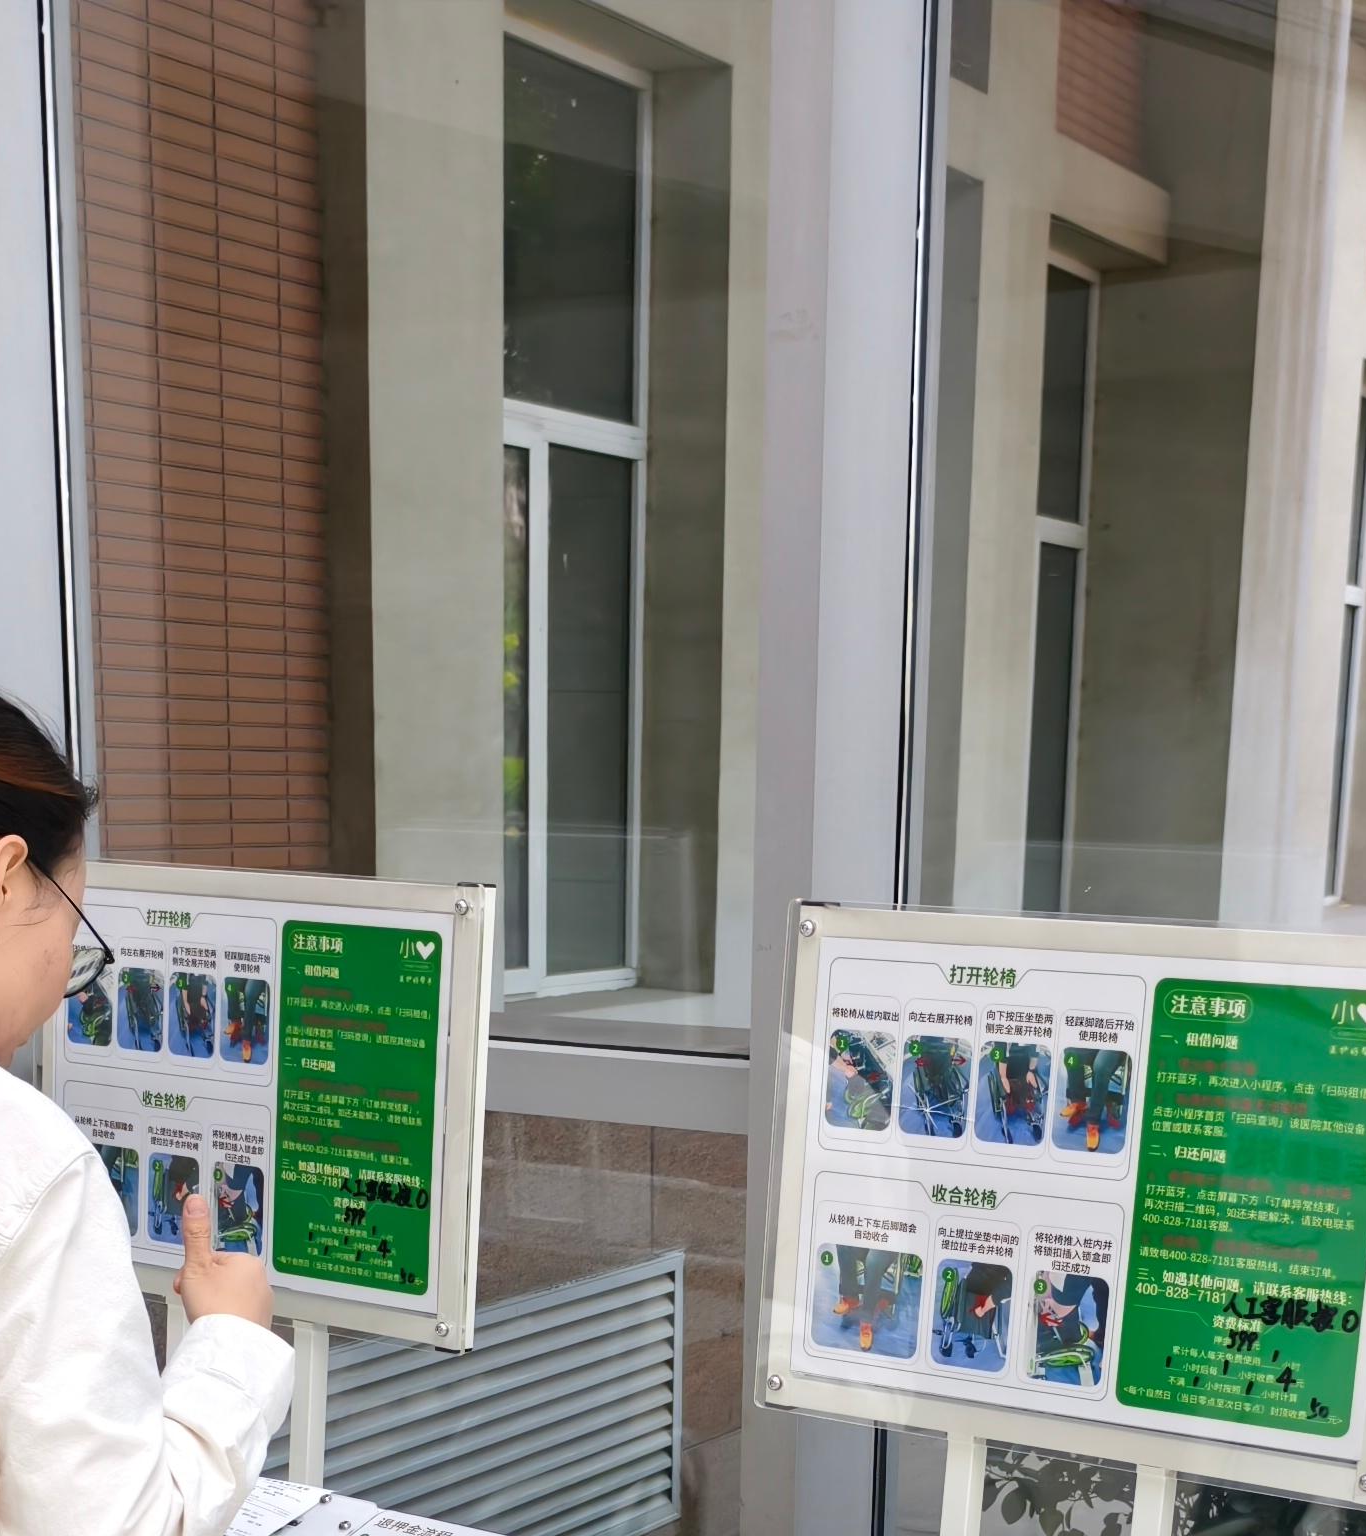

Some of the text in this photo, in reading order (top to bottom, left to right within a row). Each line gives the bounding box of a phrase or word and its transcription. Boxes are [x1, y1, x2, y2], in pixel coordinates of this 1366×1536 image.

[146, 908, 191, 928] 打开轮椅
[293, 933, 344, 954] 注意事项
[949, 965, 1016, 988] 打开轮椅
[832, 1007, 899, 1022] 将轮椅从桩内取出
[1170, 995, 1246, 1019] 注意事项
[908, 1012, 973, 1026] 向左右展开轮椅
[986, 1010, 1054, 1025] 向下按压坐垫两
[1064, 1015, 1134, 1031] 轻踩脚踏后开始
[985, 1024, 1053, 1039] 侧完全展开轮椅
[1078, 1030, 1118, 1044] 使用轮椅
[1159, 1032, 1239, 1050] 一、租借问题
[142, 1090, 186, 1110] 收合轮椅
[1147, 1144, 1227, 1164] 二、归还问题
[281, 1170, 342, 1188] 400-828-7181
[932, 1184, 997, 1208] 收合轮椅
[829, 1213, 917, 1234] 从轮椅上下车后脚踏会
[854, 1229, 889, 1243] 自动收合
[938, 1226, 1019, 1246] 向上提拉坐垫中间的
[1035, 1232, 1112, 1250] 将轮椅推入桩内并
[941, 1240, 1013, 1258] 提拉拉手合并轮椅
[1033, 1245, 1111, 1264] 将锁扣插入锁盒即
[1051, 1261, 1090, 1275] 归还成功
[1135, 1282, 1227, 1304] 400-828-7181
